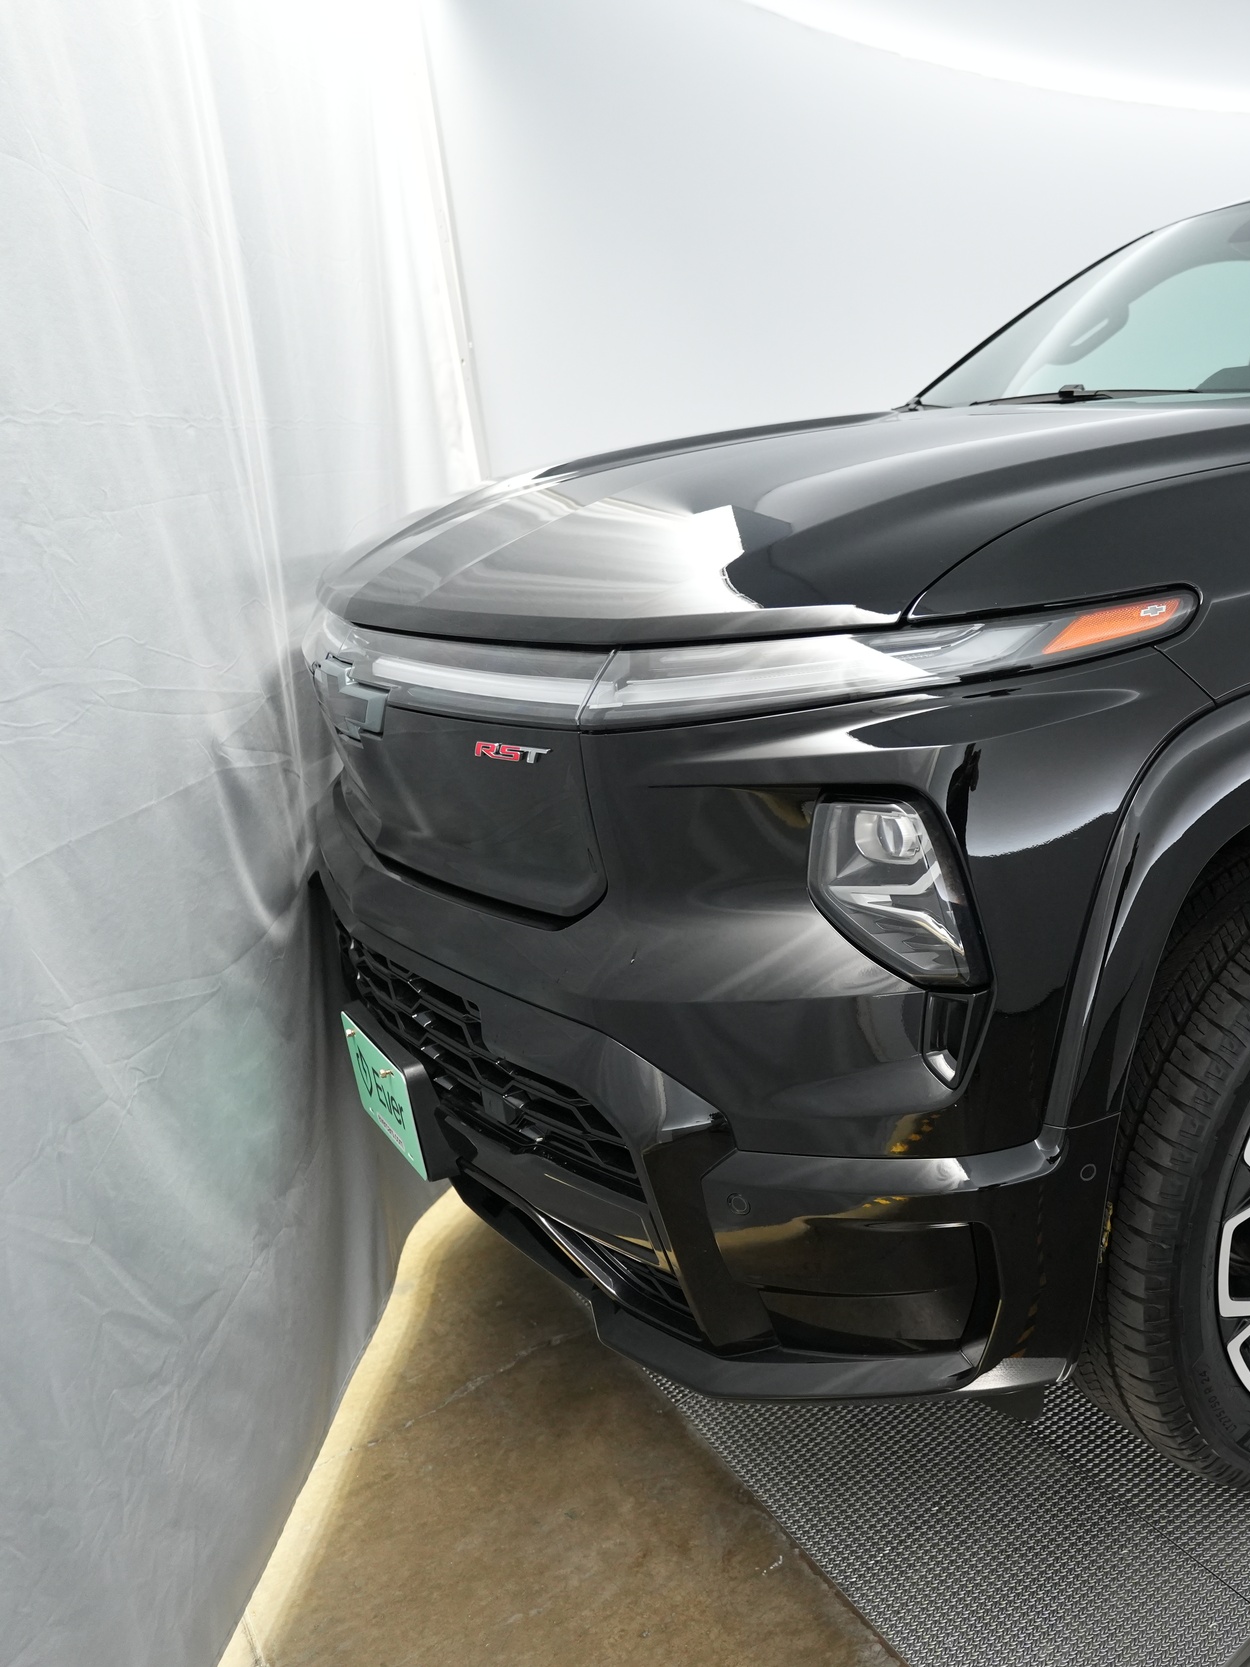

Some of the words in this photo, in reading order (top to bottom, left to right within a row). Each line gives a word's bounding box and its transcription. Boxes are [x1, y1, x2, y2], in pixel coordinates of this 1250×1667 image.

[474, 741, 551, 764] RST
[372, 1067, 406, 1130] Ever
[1199, 1370, 1210, 1384] 24
[1204, 1386, 1212, 1395] R
[1208, 1396, 1237, 1433] LT275/50
